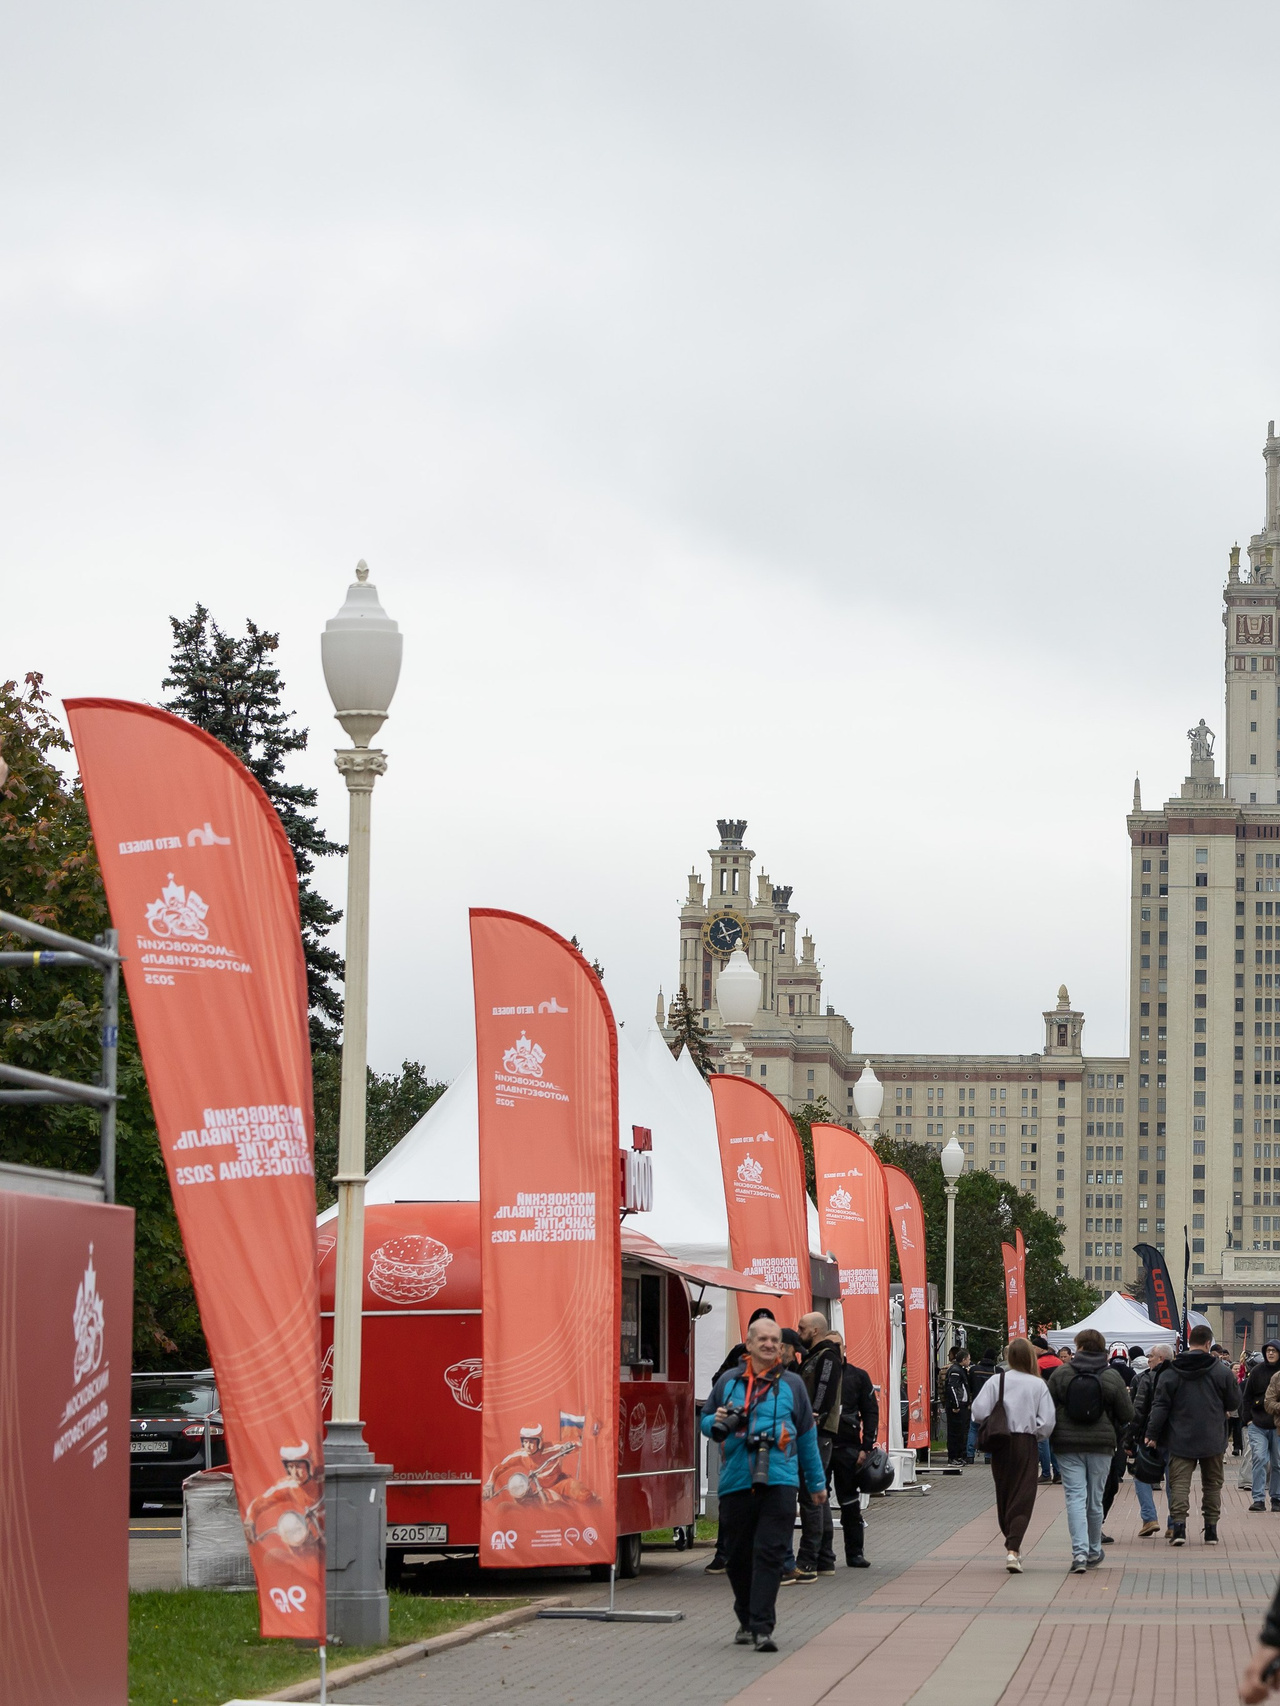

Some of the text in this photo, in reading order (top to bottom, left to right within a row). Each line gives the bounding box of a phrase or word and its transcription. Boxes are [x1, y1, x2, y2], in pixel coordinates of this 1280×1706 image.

[387, 1470, 473, 1480] ssonwheels.ru
[392, 1526, 442, 1541] 6205 77
